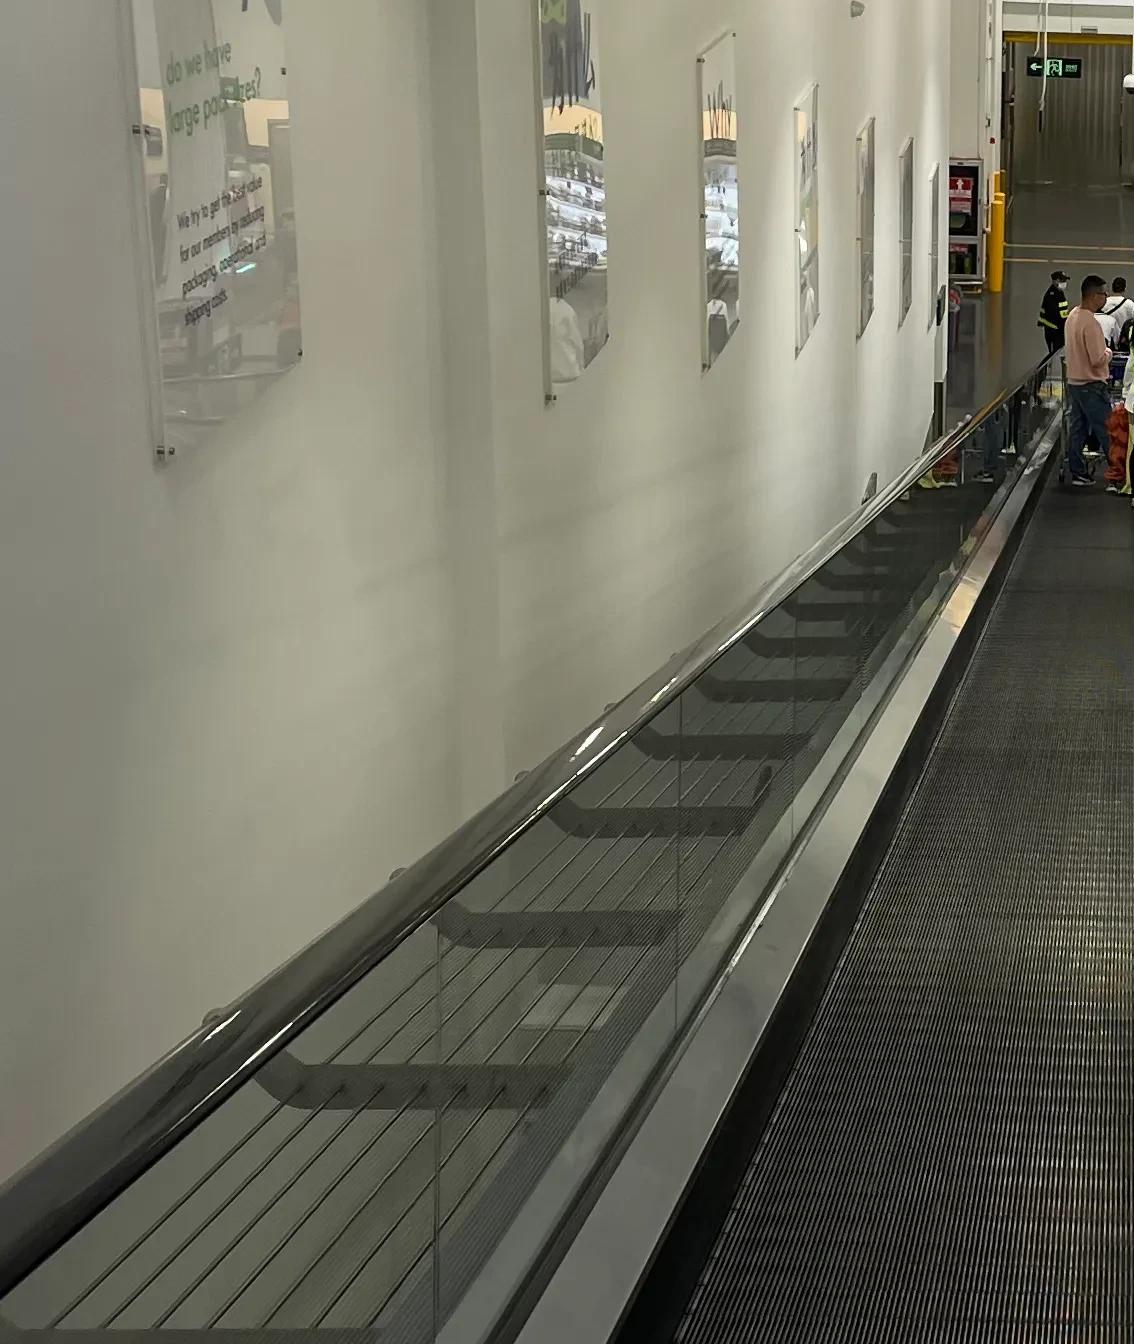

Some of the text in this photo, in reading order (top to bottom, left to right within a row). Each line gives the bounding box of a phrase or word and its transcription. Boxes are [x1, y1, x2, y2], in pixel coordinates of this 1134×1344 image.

[166, 49, 182, 86] do
[185, 54, 202, 75] we
[166, 100, 200, 137] large
